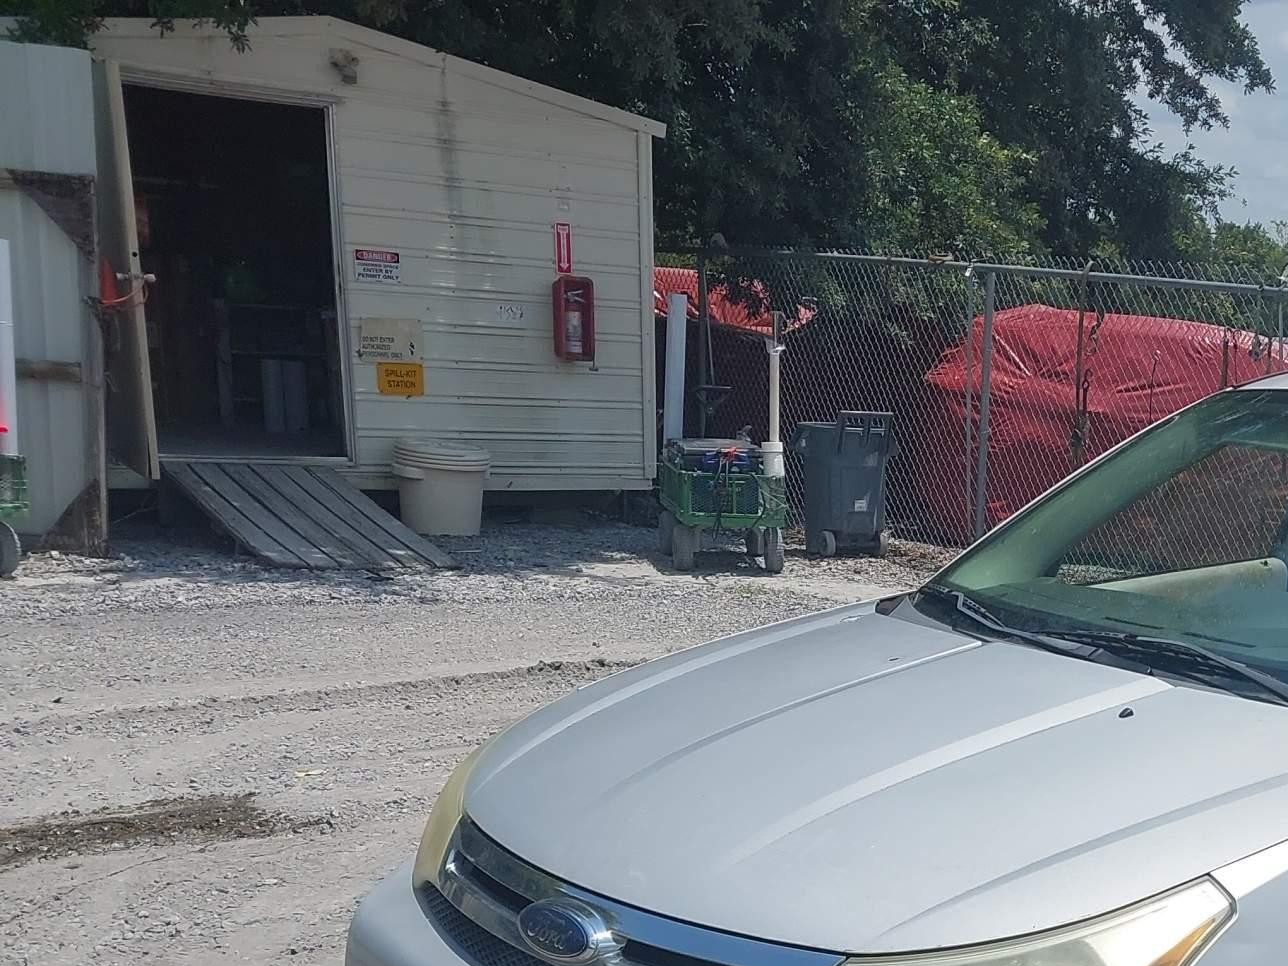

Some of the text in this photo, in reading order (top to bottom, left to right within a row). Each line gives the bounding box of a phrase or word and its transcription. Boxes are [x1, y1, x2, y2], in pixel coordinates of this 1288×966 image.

[363, 250, 392, 263] DANGER
[362, 343, 392, 351] AUTHORIZED
[384, 369, 417, 378] SPILL-KIT
[387, 380, 417, 389] STATION
[527, 909, 574, 950] Ford
